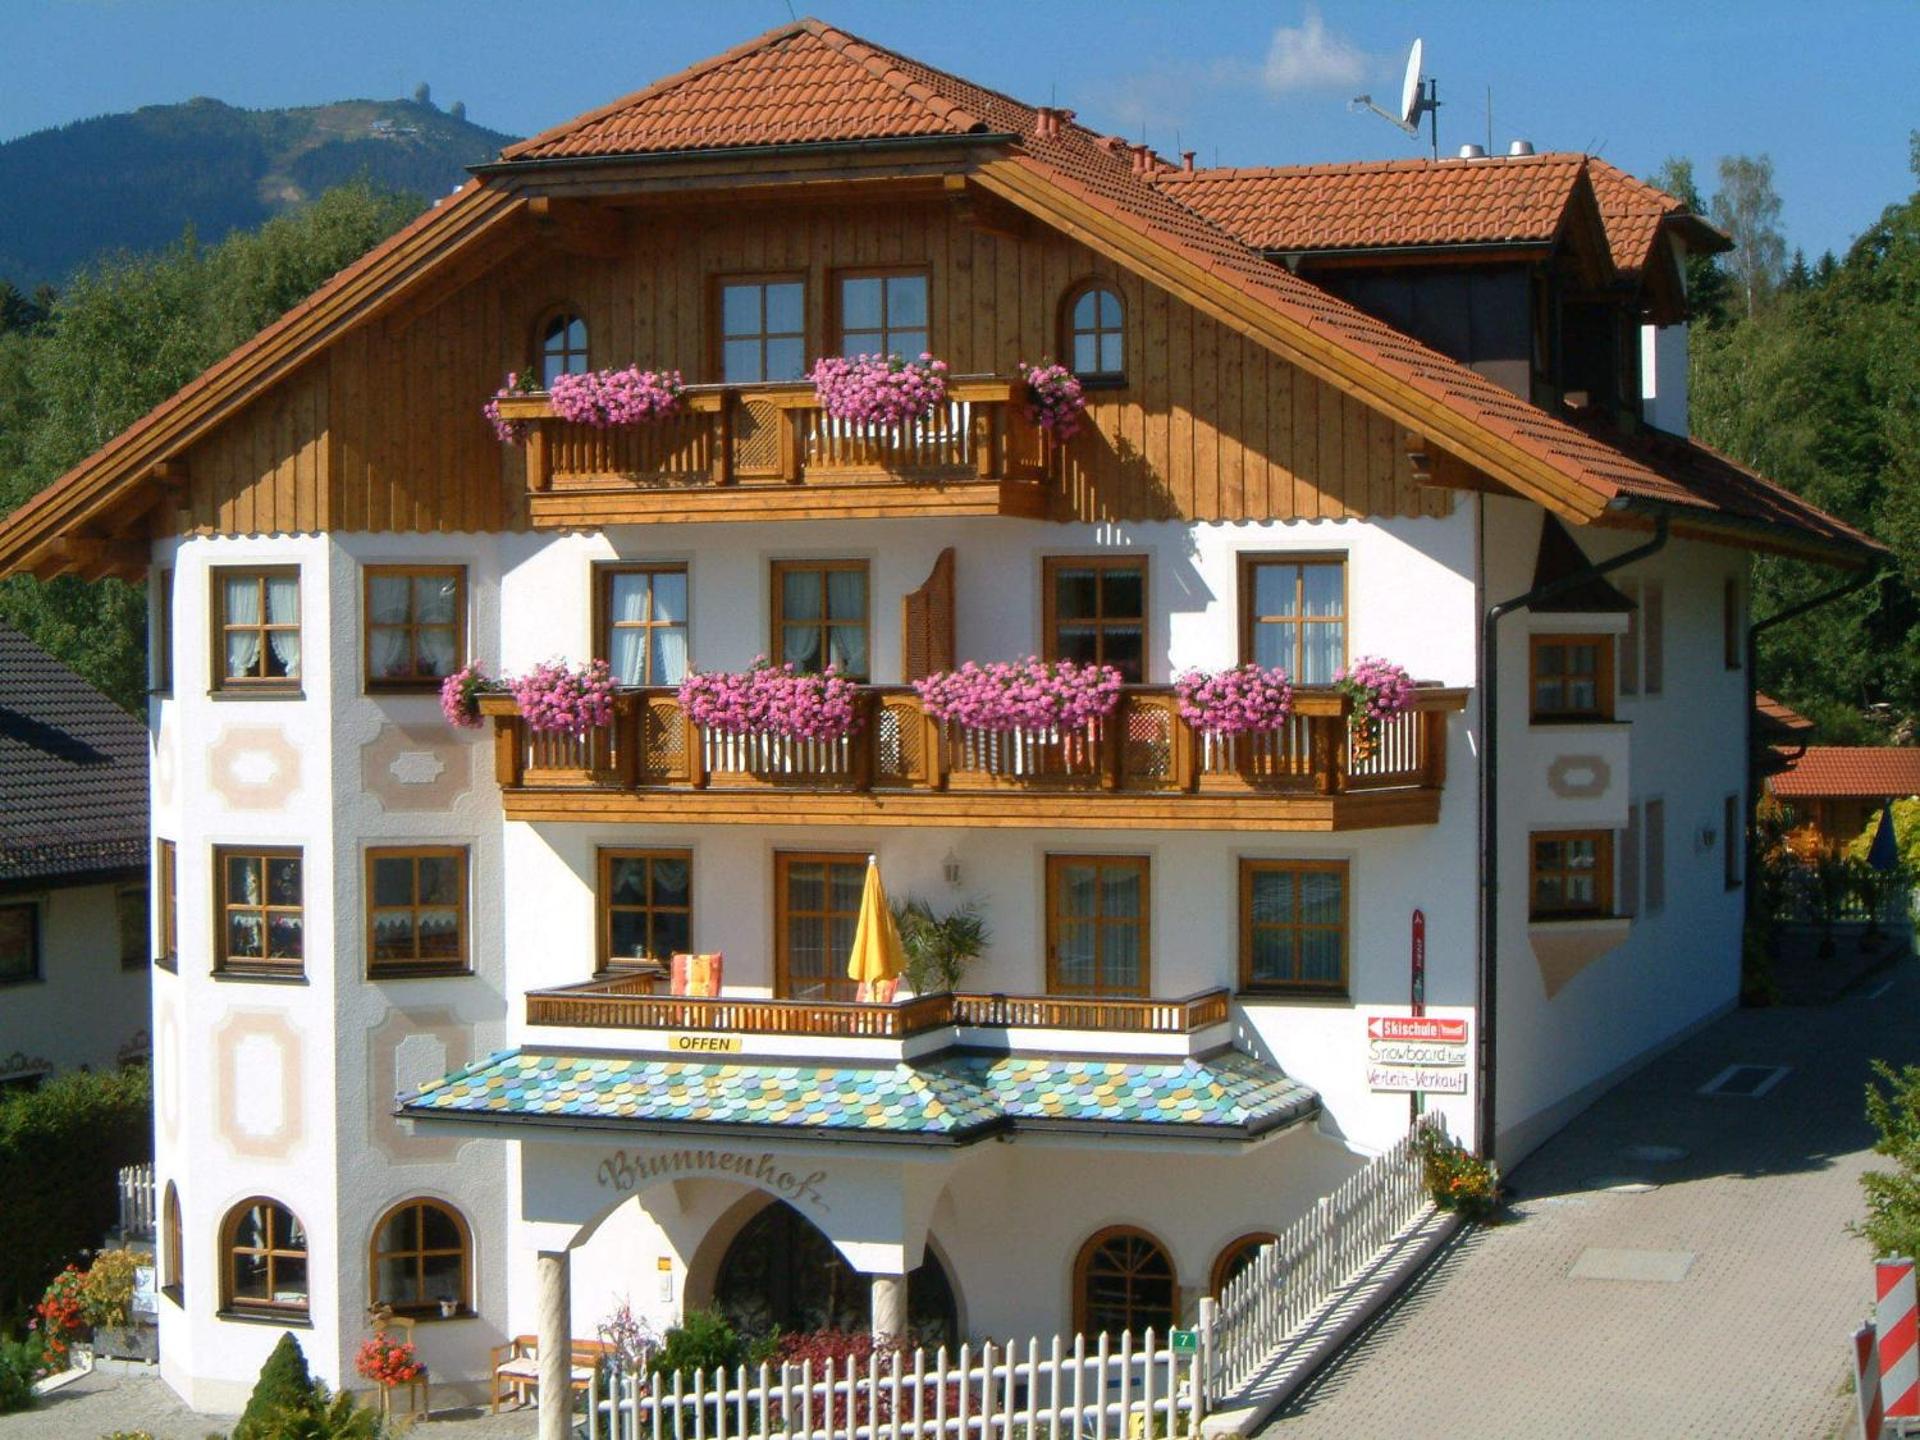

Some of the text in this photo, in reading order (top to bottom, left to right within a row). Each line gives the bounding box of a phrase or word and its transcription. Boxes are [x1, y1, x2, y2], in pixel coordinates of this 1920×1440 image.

[1384, 1021, 1437, 1036] Skischule
[679, 1037, 730, 1050] OFFEN
[598, 1149, 831, 1211] Brunnenhof
[1180, 1334, 1188, 1346] 7
